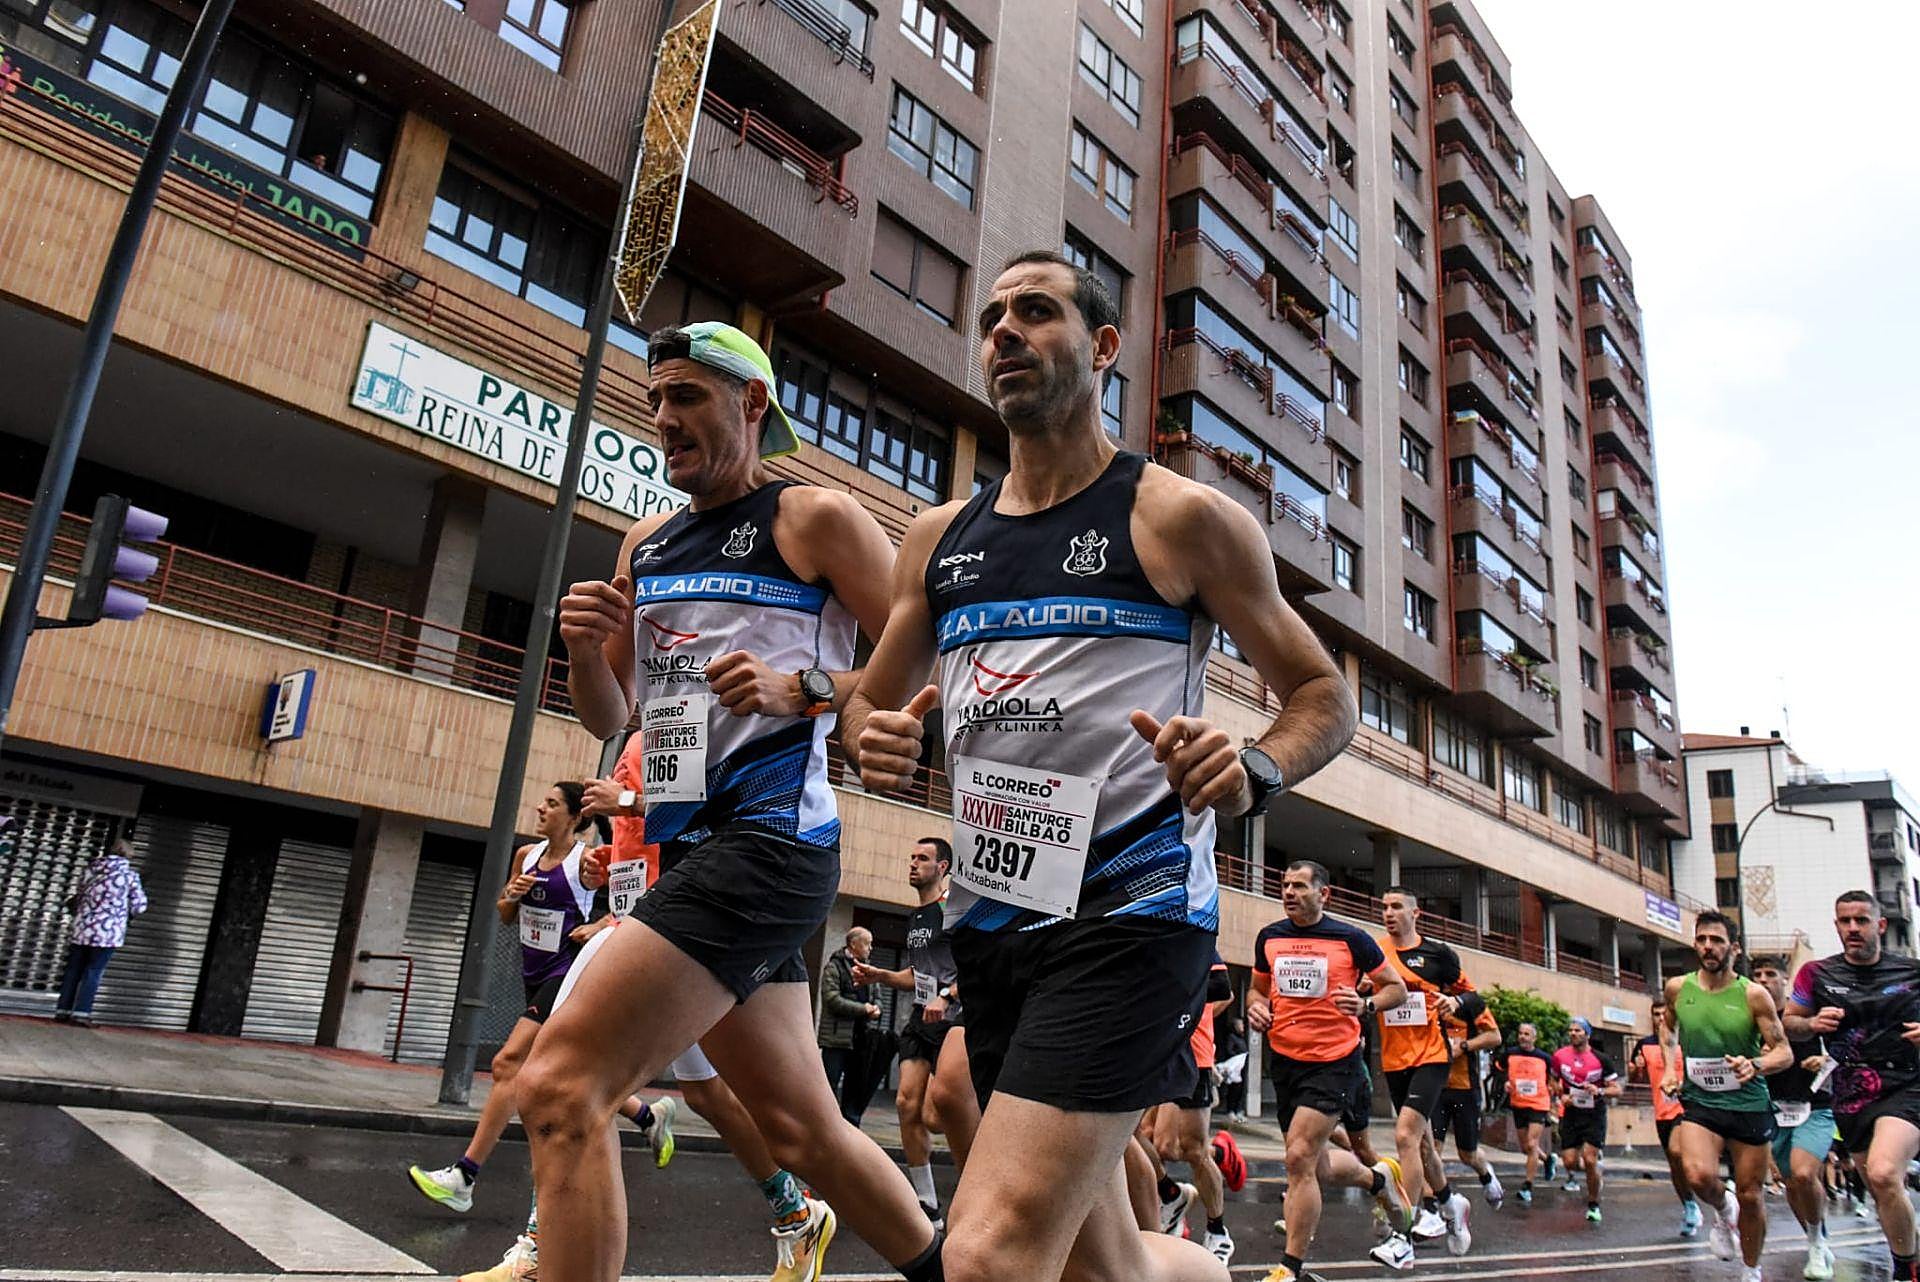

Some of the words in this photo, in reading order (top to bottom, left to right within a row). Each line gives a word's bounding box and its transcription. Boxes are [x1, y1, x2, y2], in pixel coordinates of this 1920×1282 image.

[32, 76, 179, 164] Residenca
[184, 153, 254, 198] Hotel
[259, 183, 361, 249] JADO
[476, 373, 673, 486] PAROQ
[416, 394, 505, 461] REINA
[520, 435, 557, 480] DE
[580, 464, 615, 503] OS
[651, 706, 685, 720] CORREO
[660, 726, 697, 737] SANTURCE
[994, 722, 1063, 733] KLINIKA
[660, 735, 698, 749] BILBAO
[646, 753, 679, 784] 2166
[972, 770, 985, 787] EL
[985, 774, 1054, 799] CORREO
[1004, 818, 1071, 844] BILBAO
[1006, 806, 1074, 830] SANTURCE
[972, 833, 1037, 882] 2397
[1288, 978, 1312, 990] 1642
